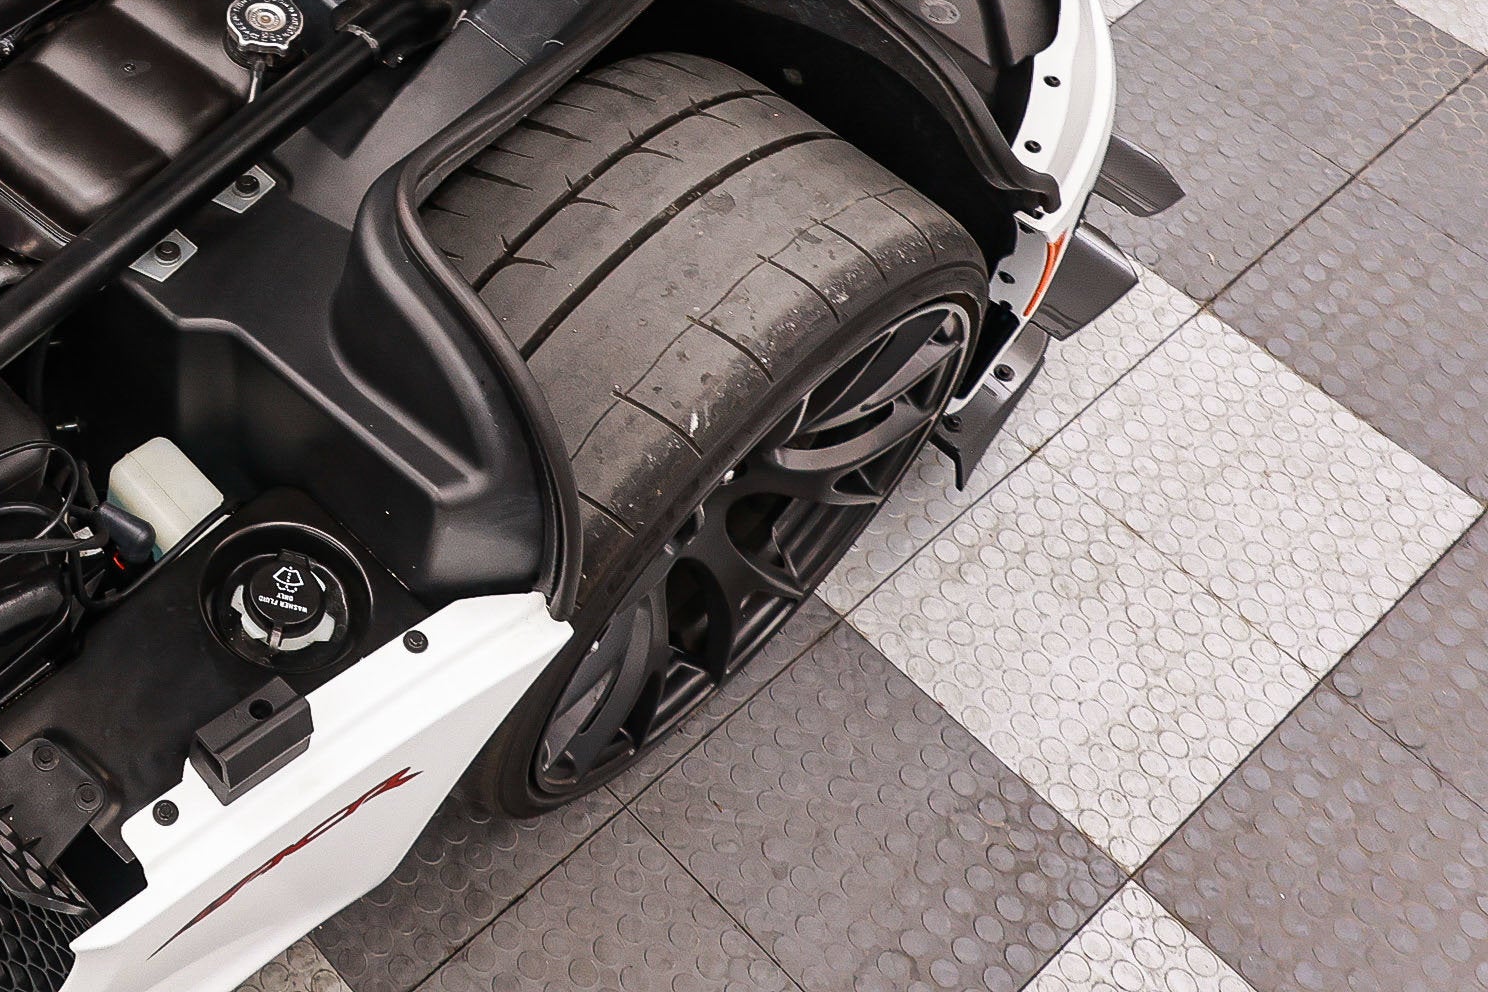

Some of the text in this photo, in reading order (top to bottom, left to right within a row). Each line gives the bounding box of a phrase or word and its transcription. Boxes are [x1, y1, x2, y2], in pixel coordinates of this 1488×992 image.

[258, 595, 308, 613] WASHER FLUID
[276, 592, 294, 602] ONLY
